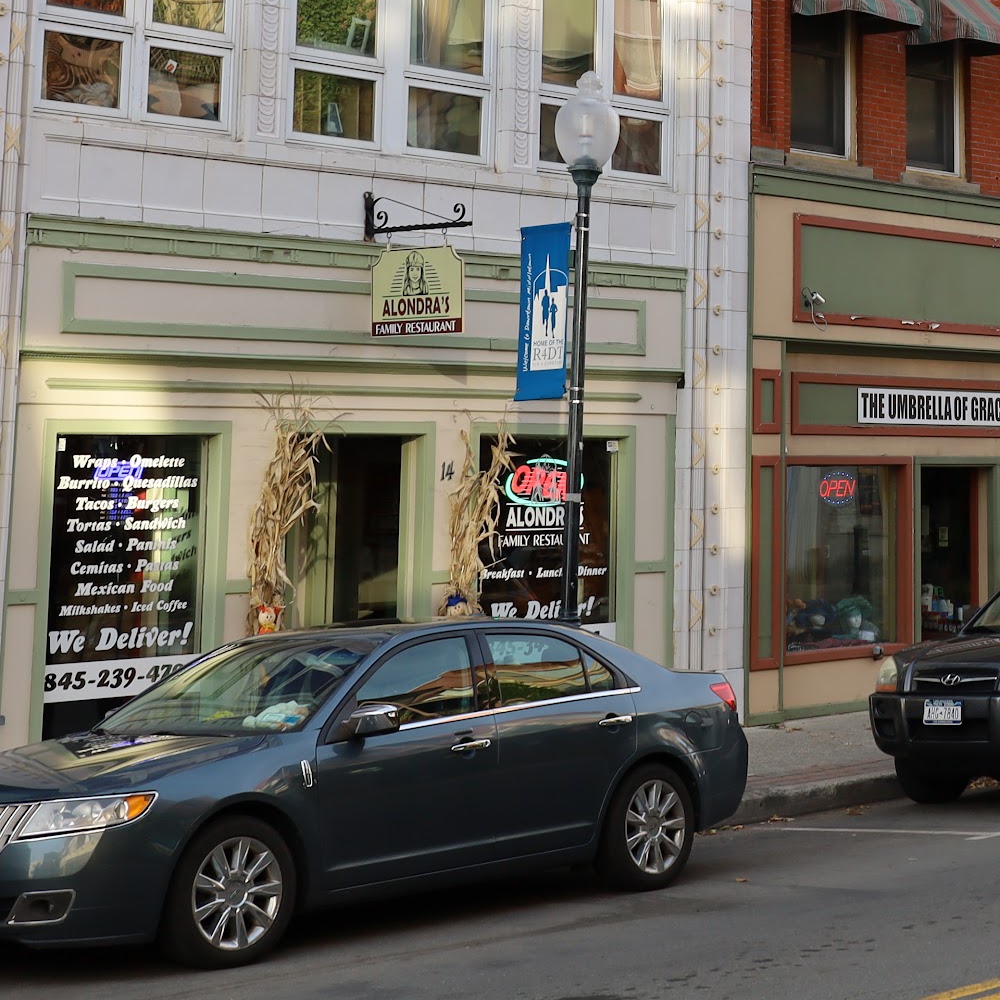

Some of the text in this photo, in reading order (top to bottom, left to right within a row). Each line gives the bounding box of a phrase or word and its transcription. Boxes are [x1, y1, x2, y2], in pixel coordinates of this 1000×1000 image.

[382, 296, 449, 316] ALONDRA'S
[375, 320, 456, 334] FAMILY RESTAURANT
[533, 346, 563, 361] R4DT
[861, 392, 885, 418] THE
[888, 393, 952, 421] UMBRELLA
[954, 396, 968, 421] OF
[73, 454, 185, 470] Wraps Omelette
[57, 475, 198, 492] Burrito Quesadillas
[819, 480, 856, 497] OPEN
[75, 495, 179, 513] Tacos Burgers
[67, 516, 186, 532] Tortas Sandwich
[75, 538, 177, 554] Salad Paninis
[498, 534, 530, 548] FAMILY
[70, 559, 179, 575] Cemitas Pastas
[481, 568, 525, 581] Breakfast
[577, 565, 607, 577] Dinner
[74, 579, 174, 597] Mexican Food
[58, 600, 187, 617] Milkshakes Iced Coffee
[491, 596, 595, 620] We Delir!
[48, 621, 194, 654] We Deliver!
[44, 664, 184, 691] 845-239-47
